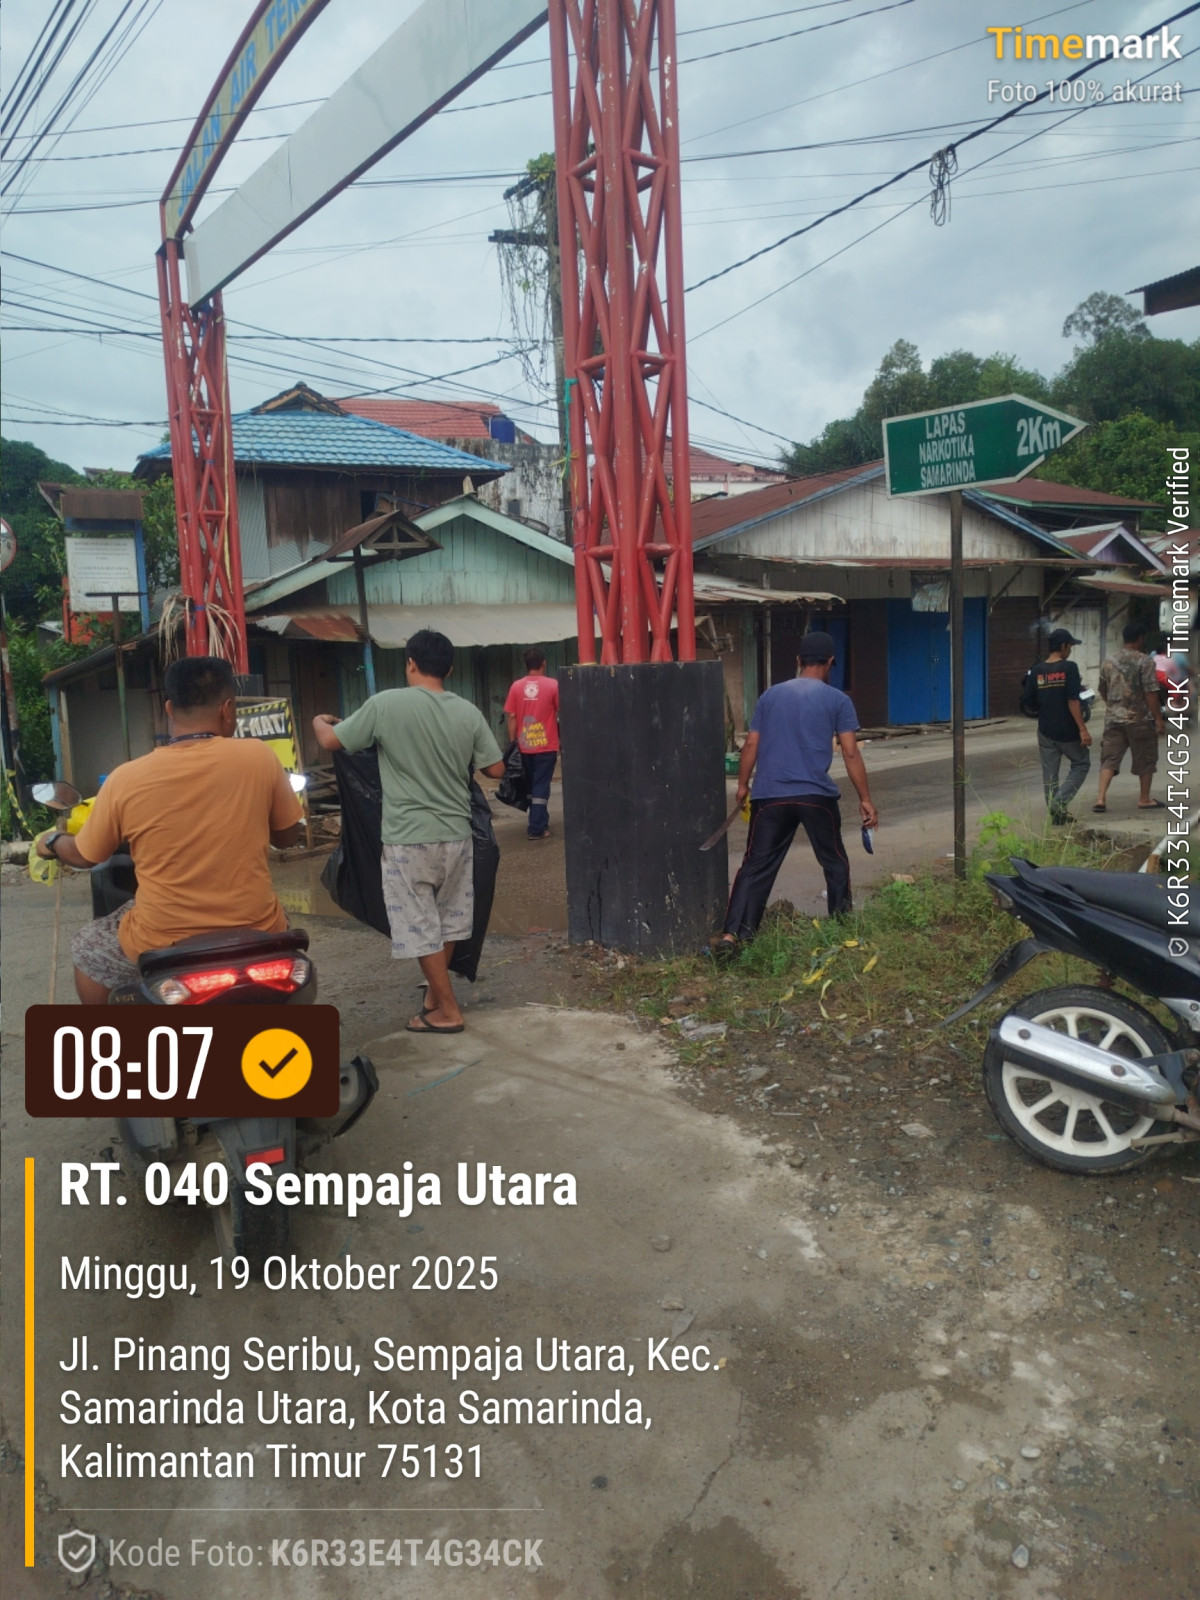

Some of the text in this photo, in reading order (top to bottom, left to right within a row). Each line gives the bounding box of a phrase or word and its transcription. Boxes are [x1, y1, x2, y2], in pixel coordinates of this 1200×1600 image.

[230, 41, 258, 116] AIR
[264, 0, 307, 53] TER
[925, 411, 966, 440] LAPAS
[1016, 415, 1062, 457] 2Km
[918, 434, 976, 465] NARKOTIKA
[919, 459, 977, 489] SAMARINDA
